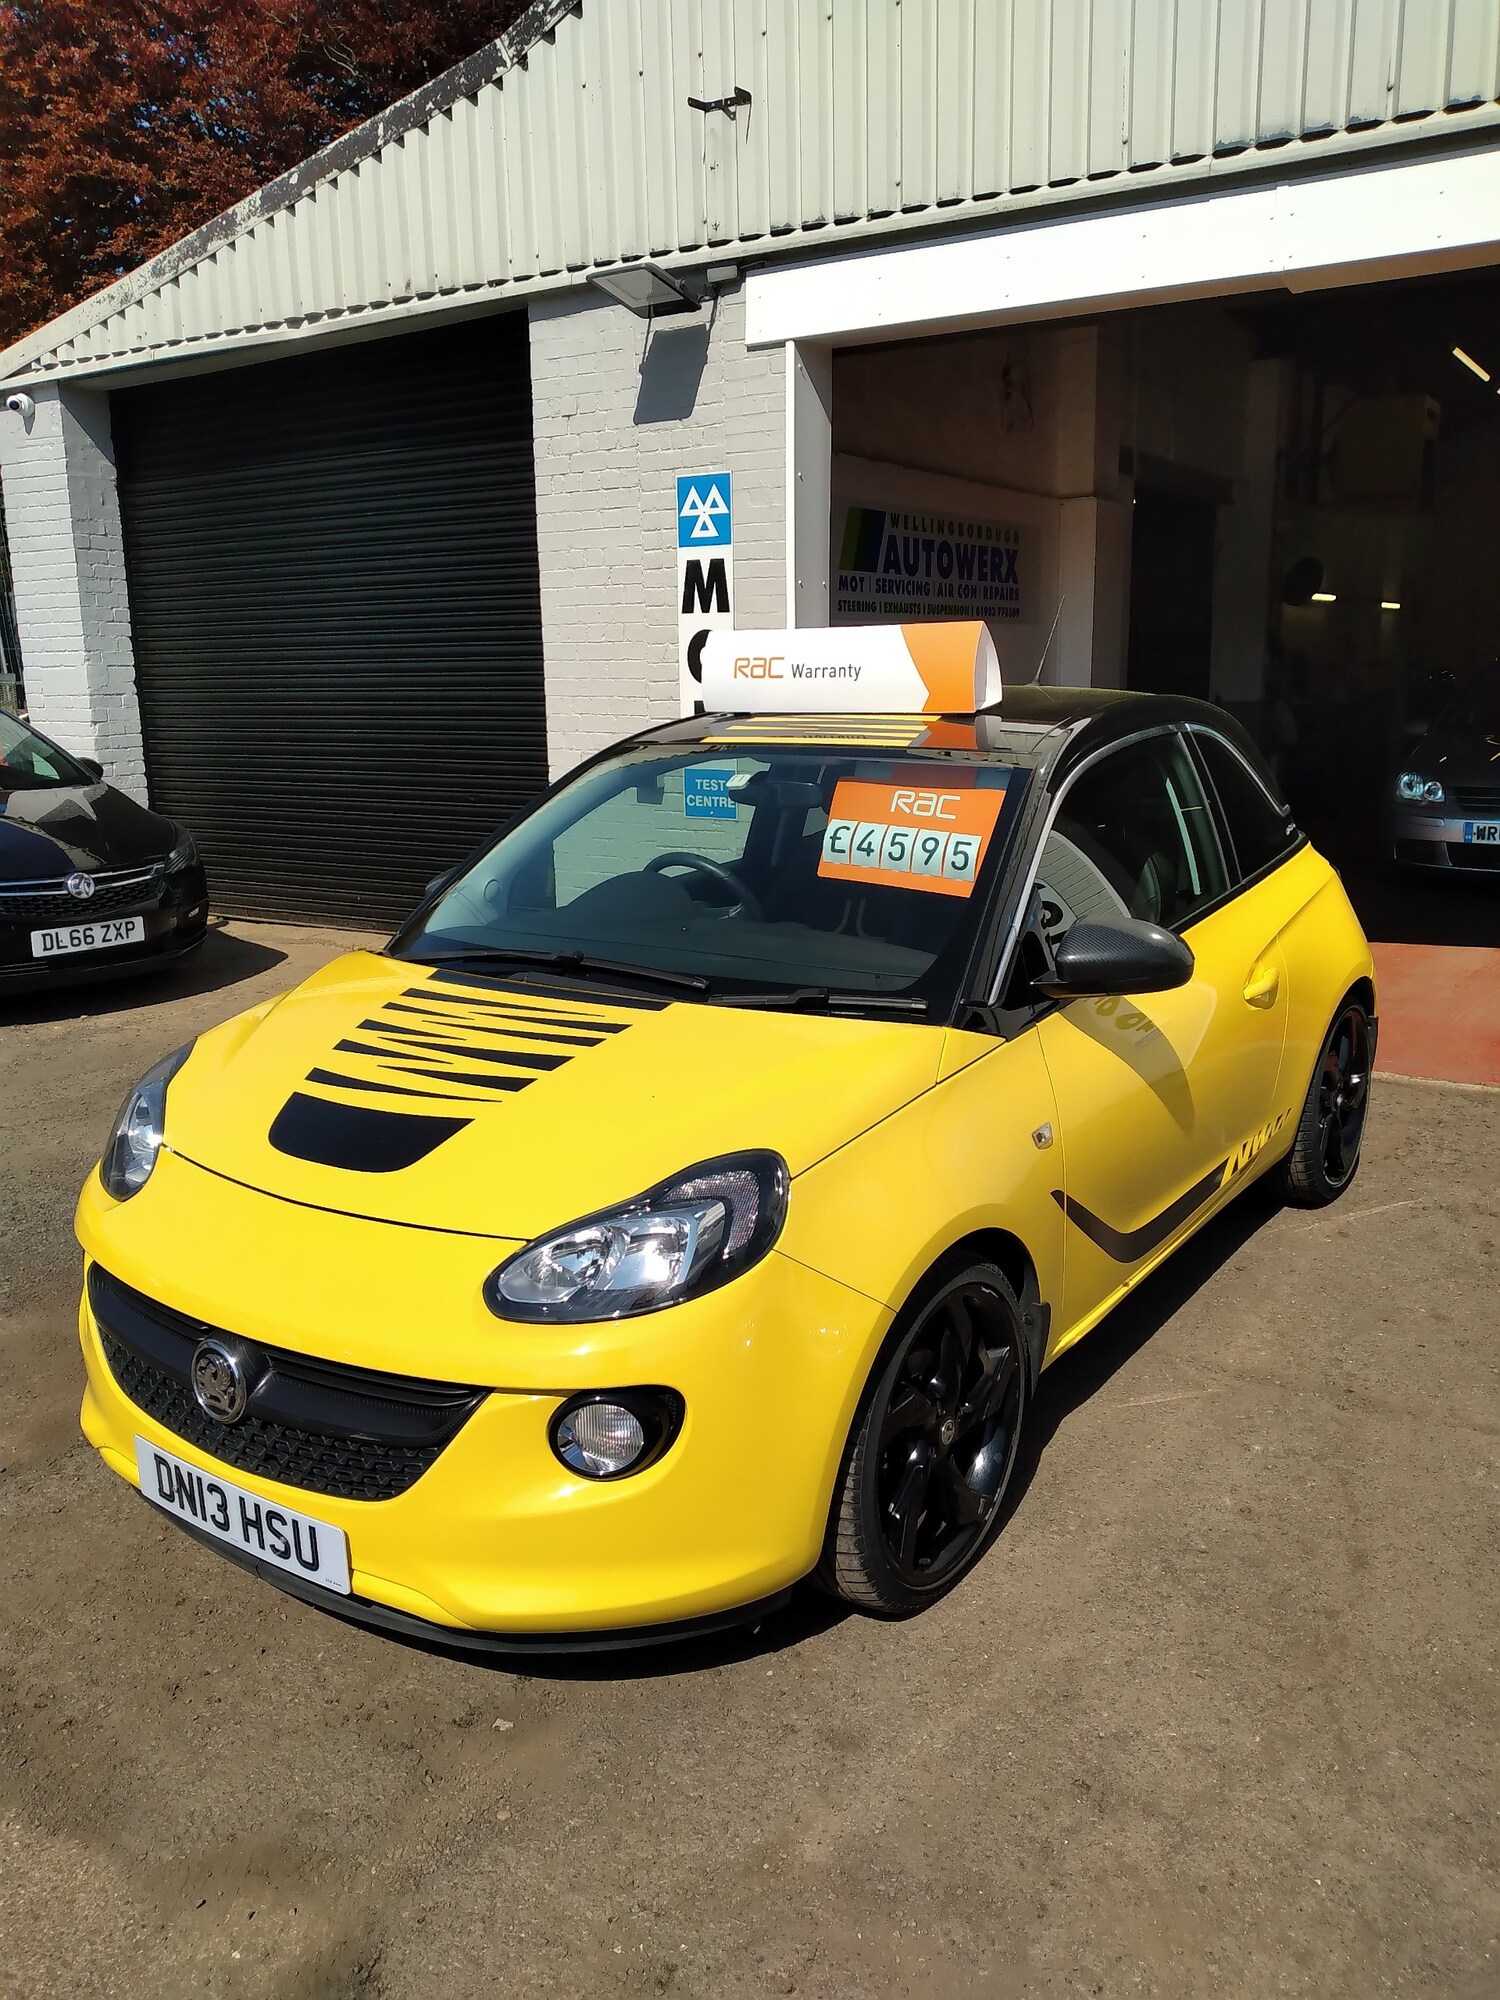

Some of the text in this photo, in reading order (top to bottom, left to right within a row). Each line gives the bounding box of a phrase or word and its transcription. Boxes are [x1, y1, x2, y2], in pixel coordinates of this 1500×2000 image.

[890, 512, 1020, 545] WELLINGBOROUGH
[882, 534, 1019, 584] AUTOWERX
[838, 574, 1019, 602] MOT SERVICING AIR CON REPAIRS
[837, 599, 877, 614] STEERING
[884, 602, 921, 615] EXHAUSTS
[927, 604, 970, 617] SUSPENSION
[791, 663, 861, 682] Warranty
[695, 779, 726, 791] TEST
[686, 794, 736, 809] CENTRE
[1476, 825, 1500, 841] WR
[829, 825, 973, 872] £4595
[41, 920, 136, 952] DL66 ZXP
[154, 1453, 320, 1572] DN13 HSU
